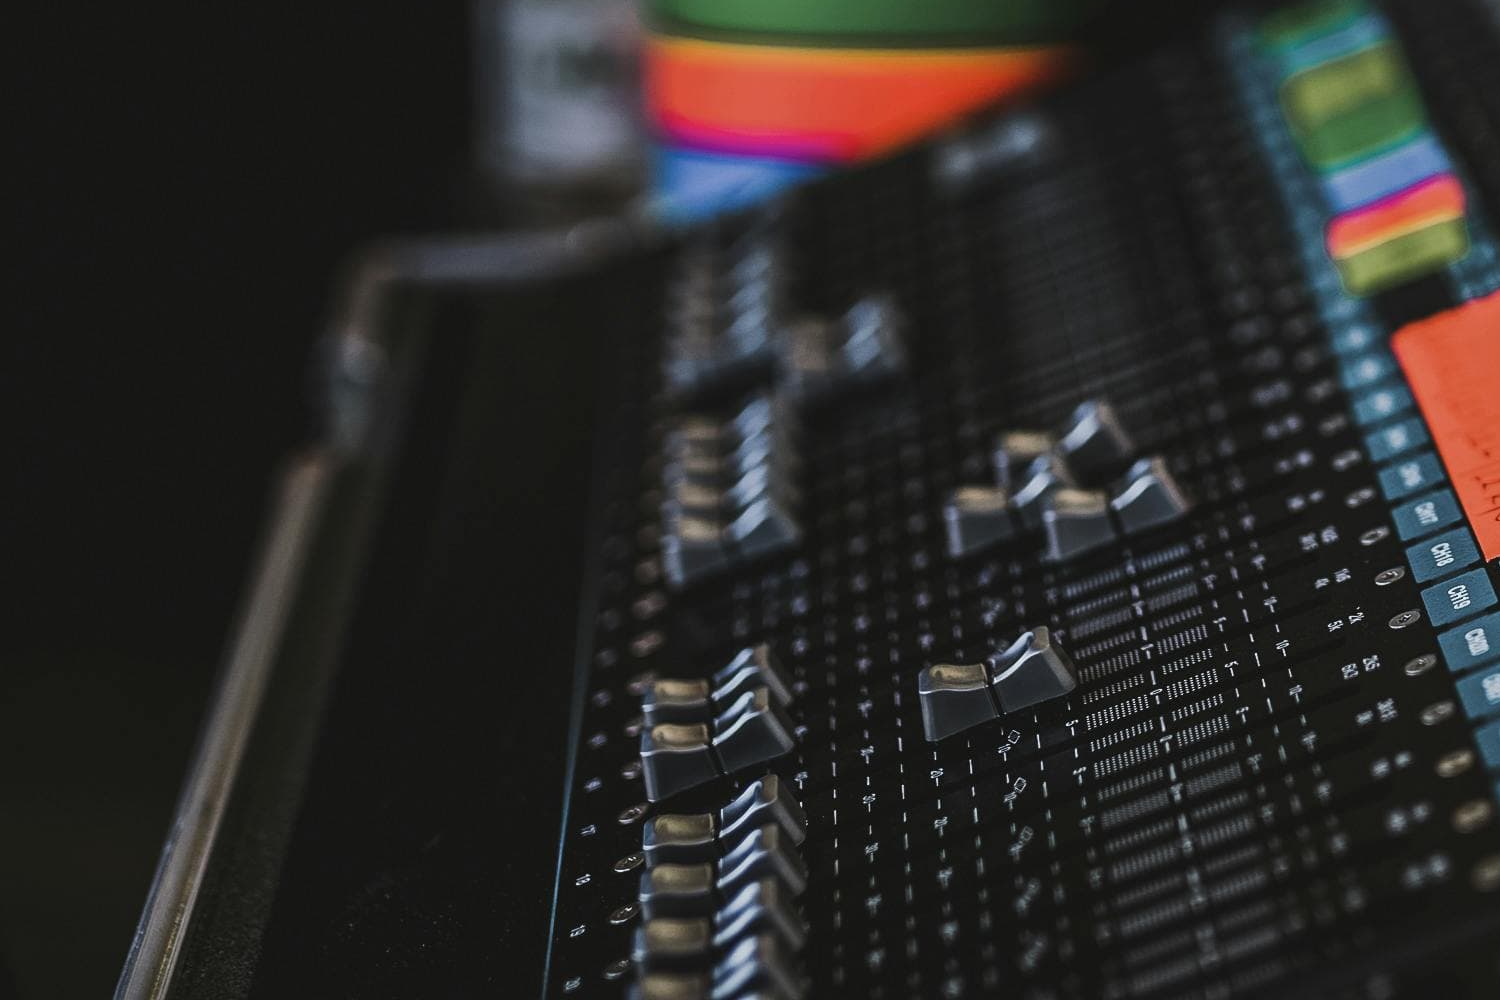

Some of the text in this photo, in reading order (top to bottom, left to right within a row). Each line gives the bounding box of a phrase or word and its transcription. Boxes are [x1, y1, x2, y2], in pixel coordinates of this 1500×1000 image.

[1430, 542, 1455, 567] CH18
[1447, 584, 1471, 610] CH19
[1327, 619, 1344, 632] 5k
